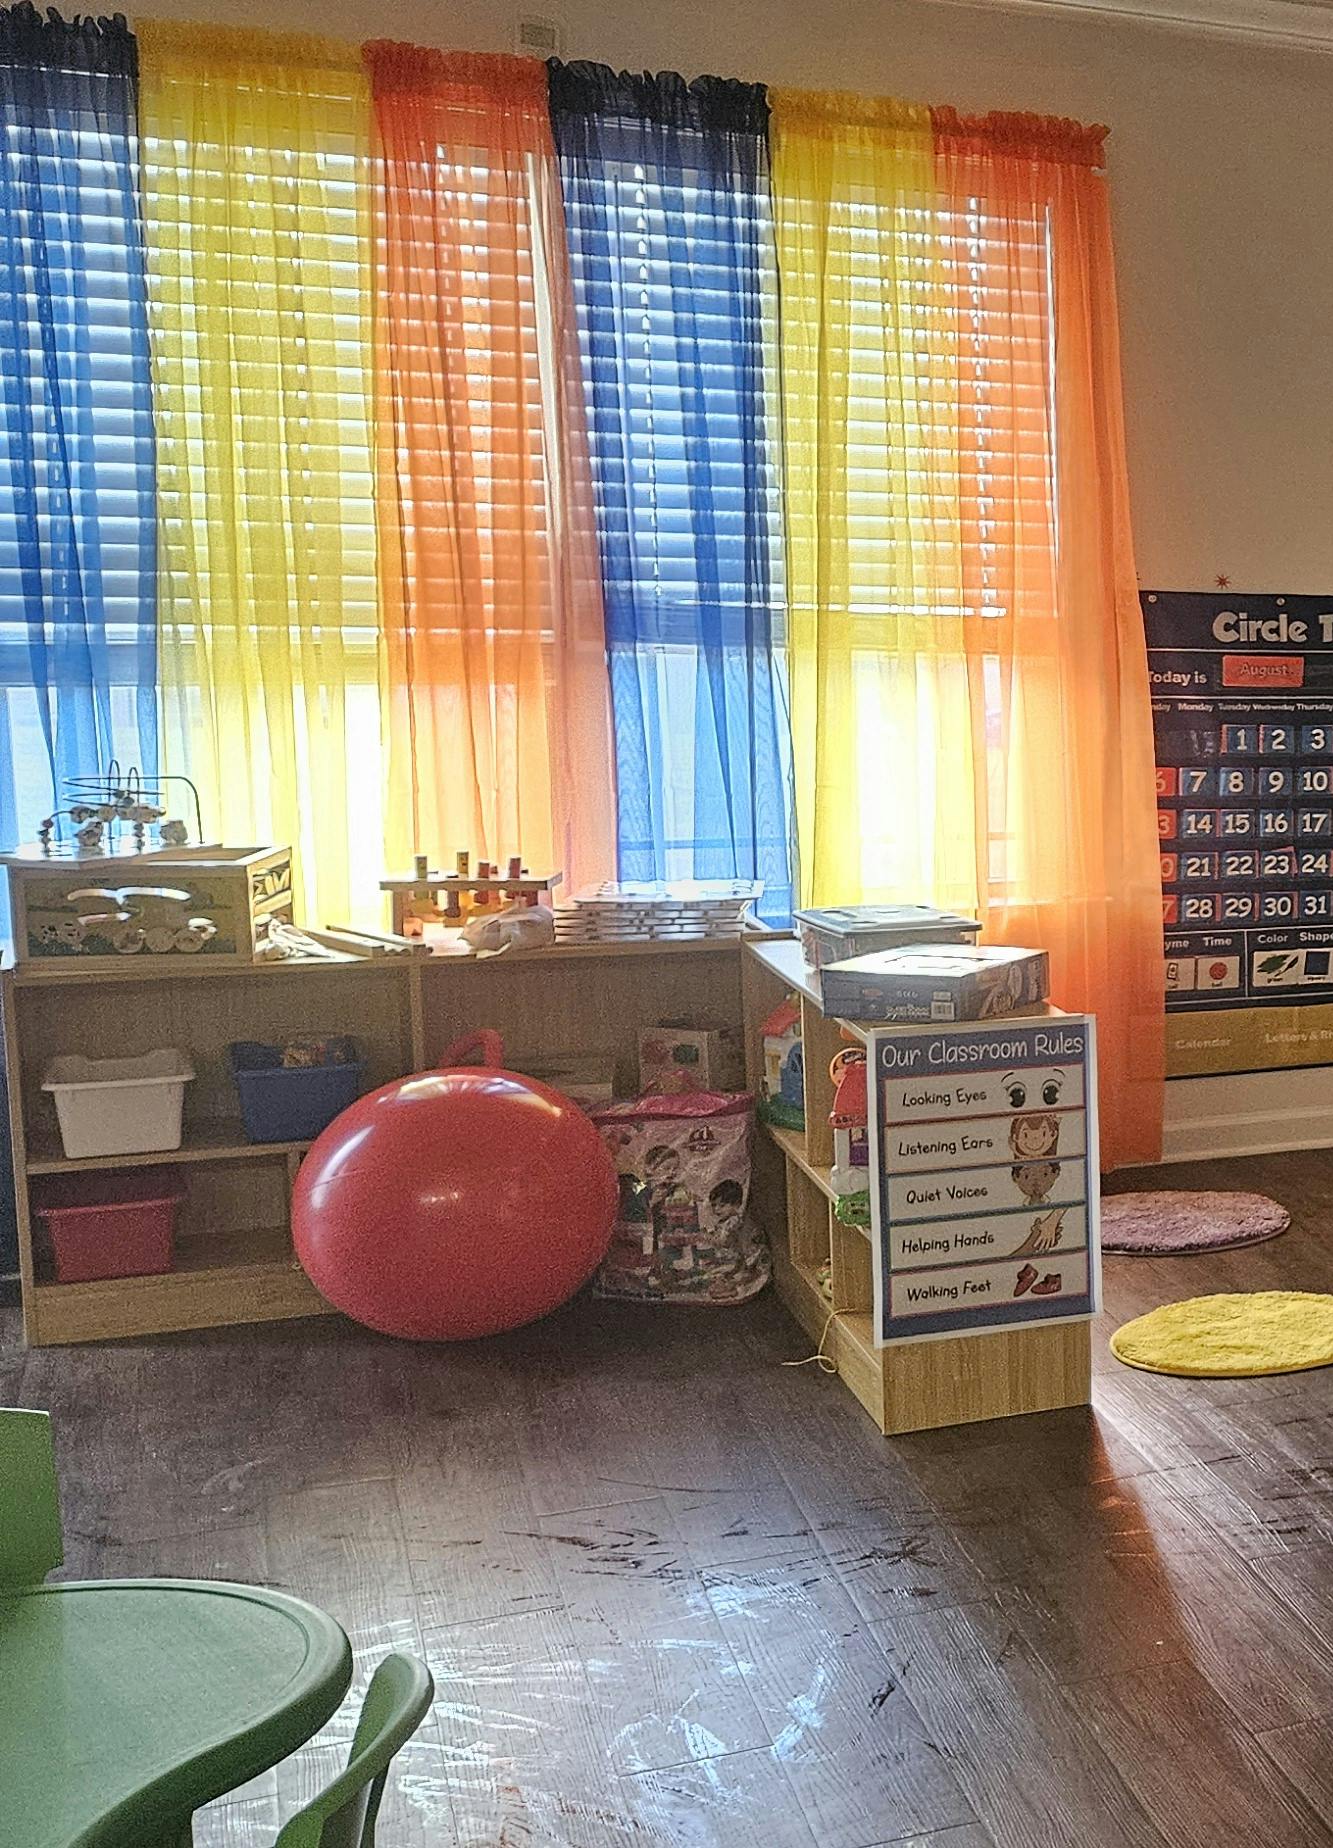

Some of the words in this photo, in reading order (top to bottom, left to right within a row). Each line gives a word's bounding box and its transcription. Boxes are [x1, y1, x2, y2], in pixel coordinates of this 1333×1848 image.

[1212, 611, 1308, 643] Circle
[1194, 671, 1207, 684] is
[1240, 664, 1288, 676] August
[1178, 703, 1214, 713] Monday
[1218, 703, 1251, 713] Tuesday
[1296, 702, 1333, 713] Thursday
[1236, 729, 1248, 750] 1
[1270, 728, 1286, 750] 2
[1310, 728, 1326, 750] 3
[1190, 771, 1208, 792] 7
[1228, 771, 1244, 792] 8
[1268, 771, 1284, 792] 9
[1302, 771, 1328, 792] 10
[1186, 814, 1212, 834] 14
[1224, 814, 1250, 834] 15
[1264, 813, 1288, 834] 16
[1302, 813, 1328, 833] 17
[1186, 857, 1212, 877] 21
[1225, 856, 1254, 876] 22
[1264, 856, 1290, 876] 23
[1301, 854, 1328, 873] 24
[1185, 899, 1214, 918] 28
[1224, 898, 1252, 918] 29
[1263, 896, 1292, 917] 30
[1304, 896, 1327, 916] 31
[1203, 936, 1232, 946] Time
[1258, 932, 1288, 943] Color
[881, 1044, 920, 1068] Our
[928, 1038, 1028, 1066] Classroom
[1034, 1031, 1083, 1056] Rules
[902, 1092, 951, 1108] Looking
[956, 1088, 988, 1104] Eyes
[898, 1140, 956, 1156] Listening
[962, 1136, 993, 1150] Ears
[906, 1189, 941, 1204] Quiet
[946, 1186, 988, 1200] Voices
[902, 1238, 950, 1254] Helping
[954, 1232, 994, 1248] Hands
[907, 1284, 958, 1302] Walking
[962, 1280, 992, 1294] Feet
